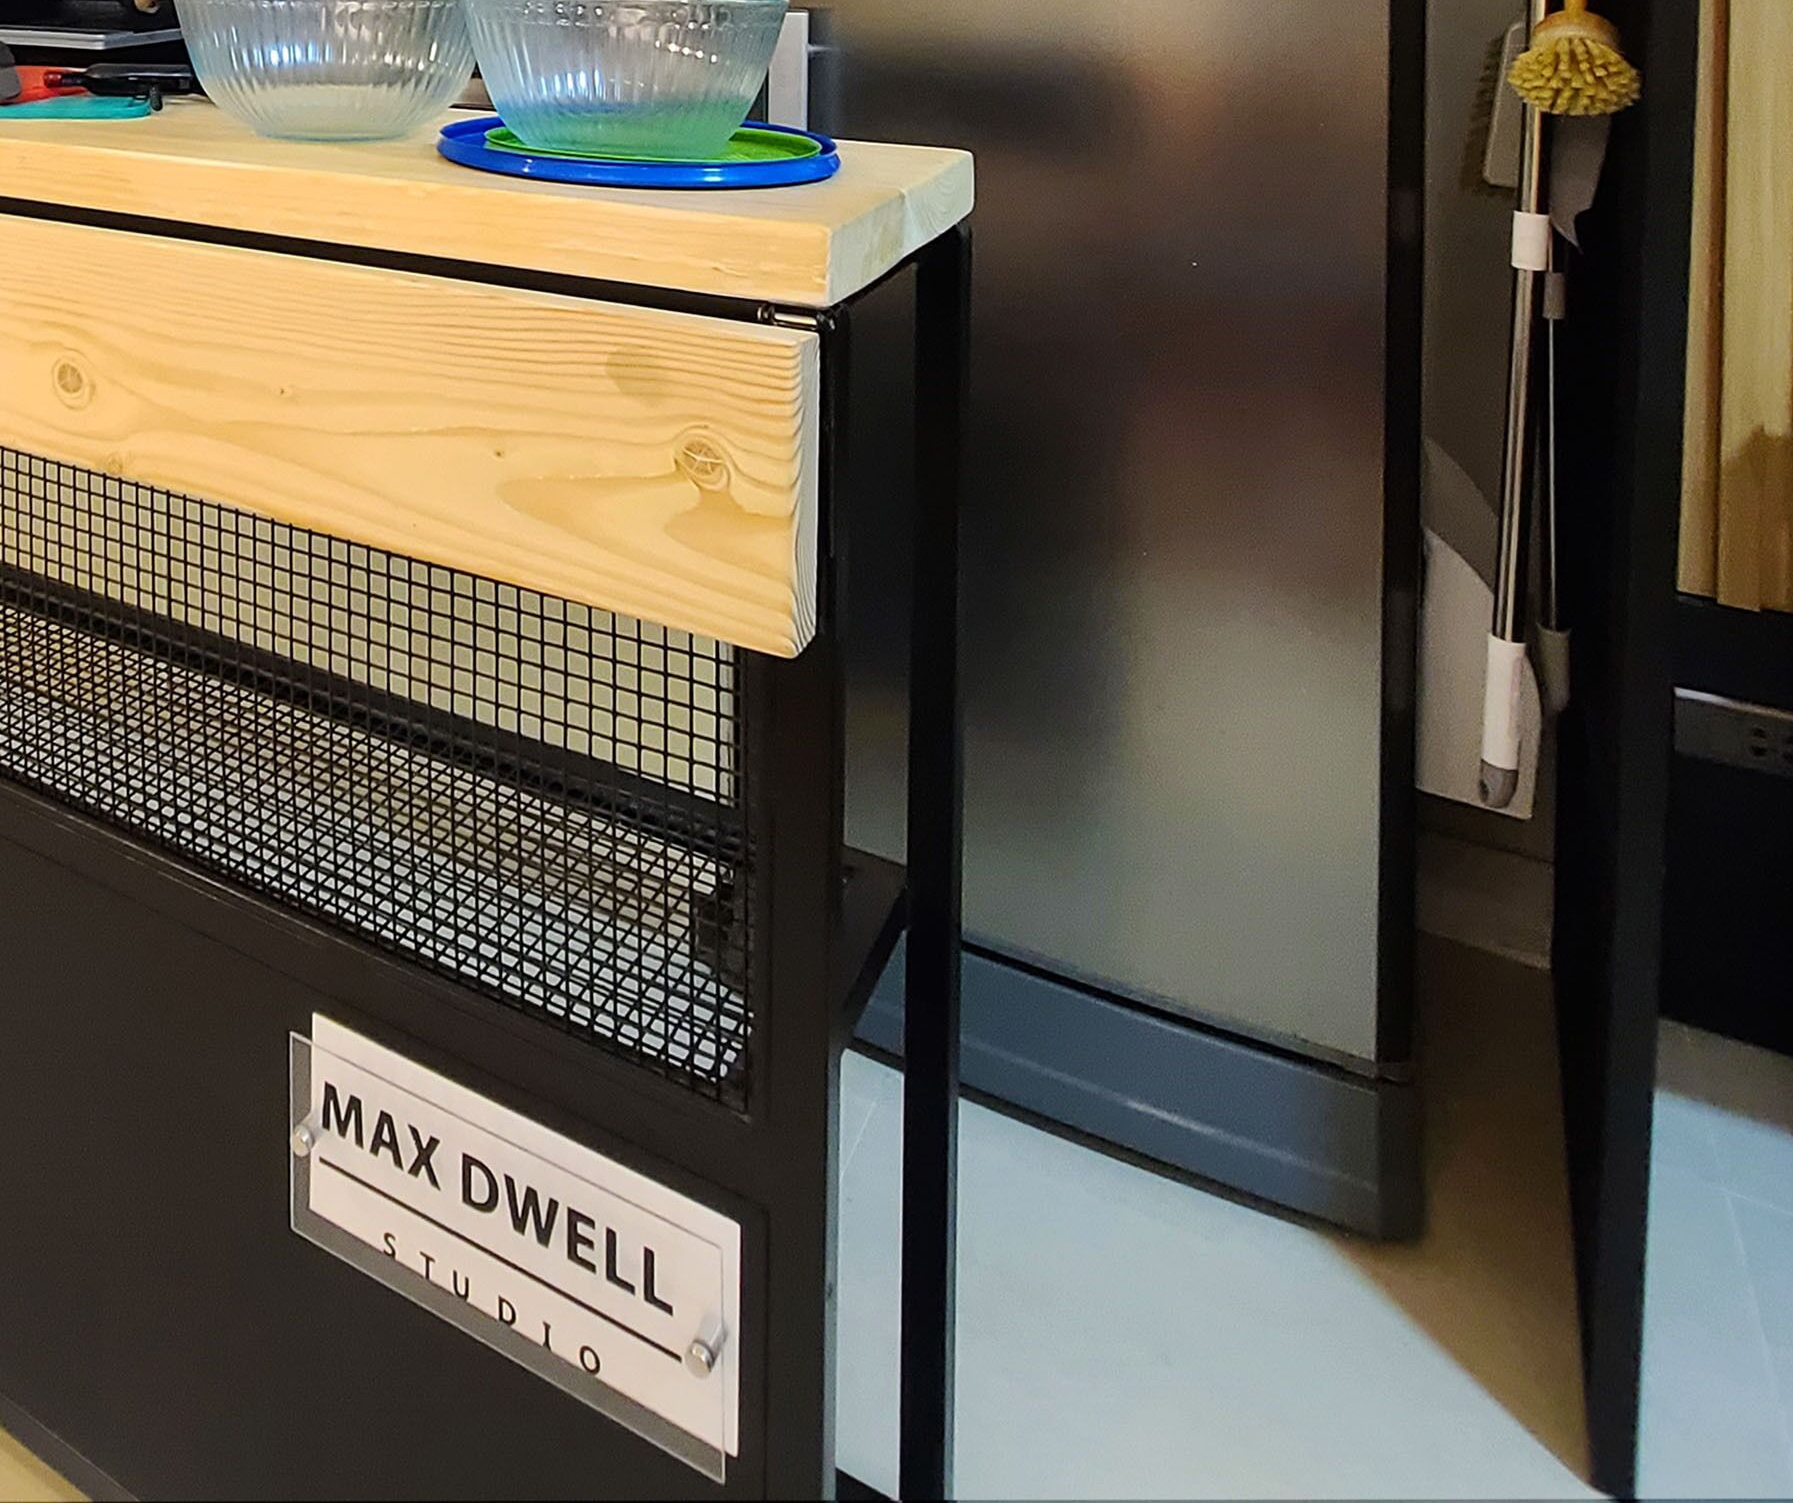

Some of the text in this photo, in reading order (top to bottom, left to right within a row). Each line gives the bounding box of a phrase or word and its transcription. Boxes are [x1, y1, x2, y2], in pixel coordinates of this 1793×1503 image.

[321, 1080, 675, 1317] MAX DWELL
[383, 1231, 601, 1376] STUDIO
